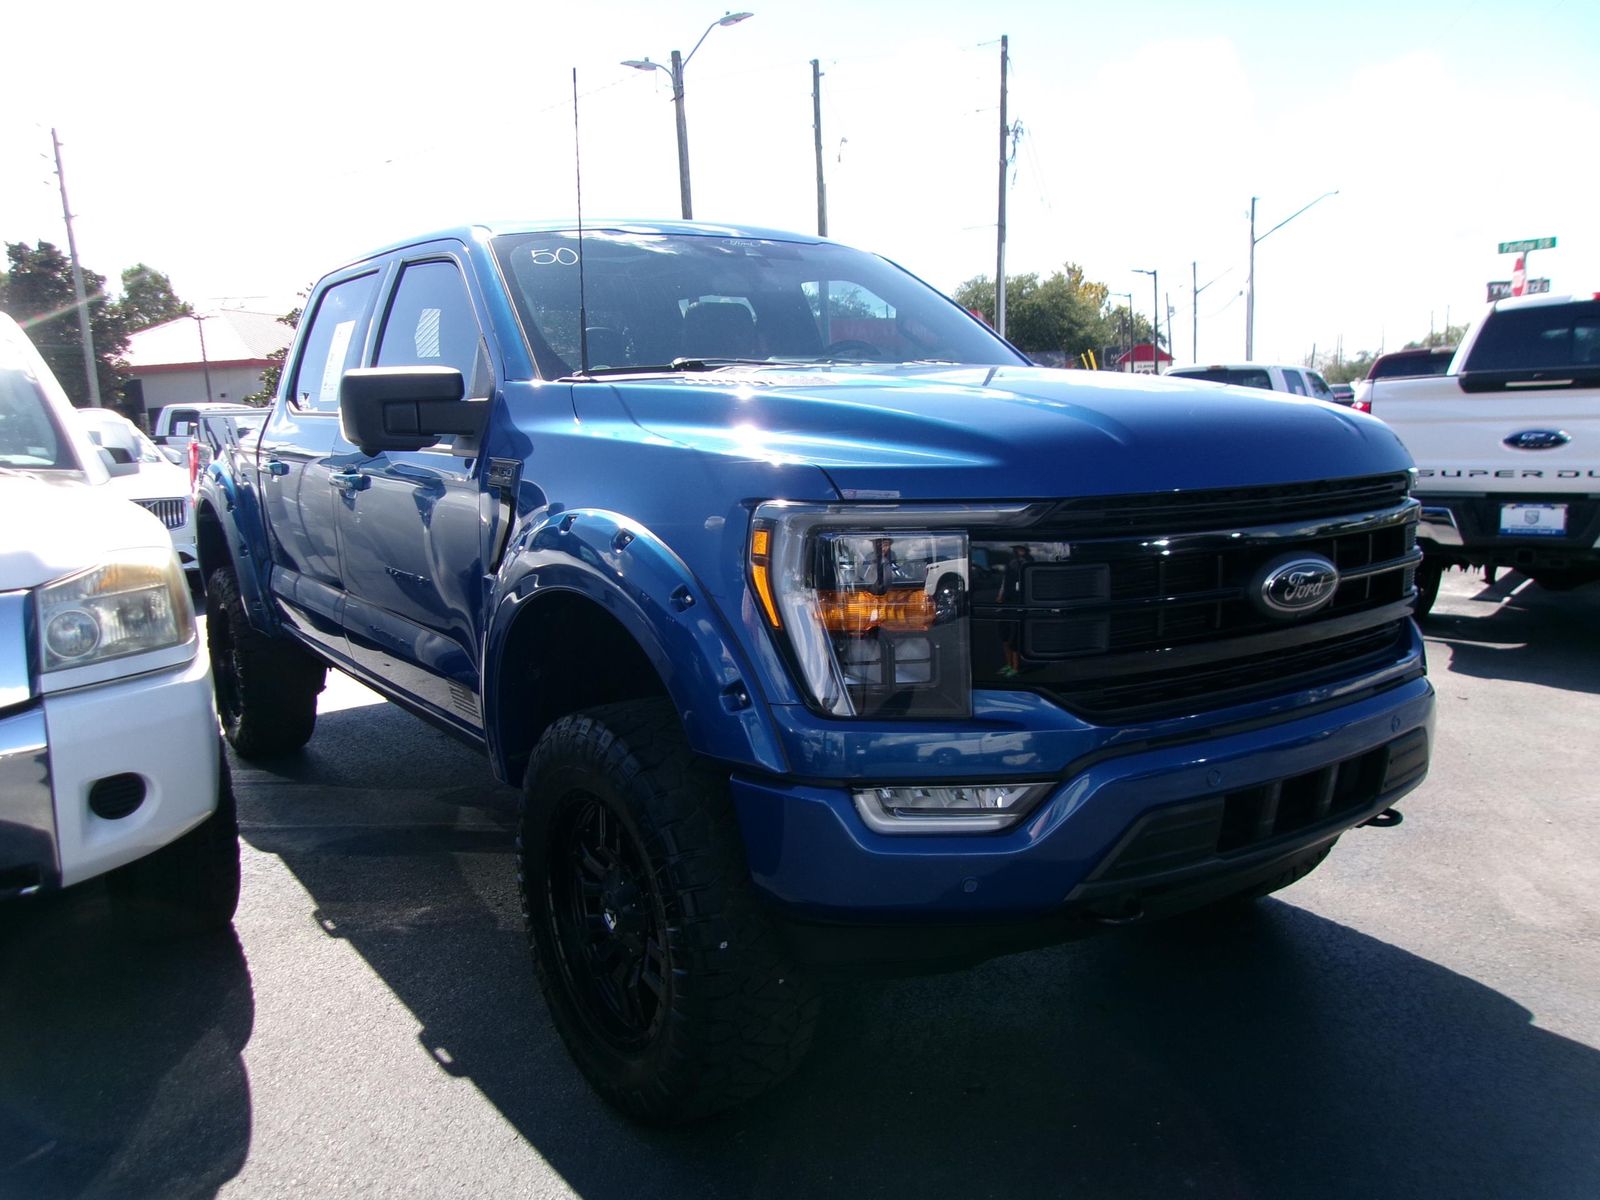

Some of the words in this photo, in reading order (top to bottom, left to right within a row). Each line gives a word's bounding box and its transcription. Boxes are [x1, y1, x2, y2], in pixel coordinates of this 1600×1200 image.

[531, 247, 579, 266] 50
[1418, 469, 1544, 479] SUPER
[1284, 570, 1325, 601] Ford
